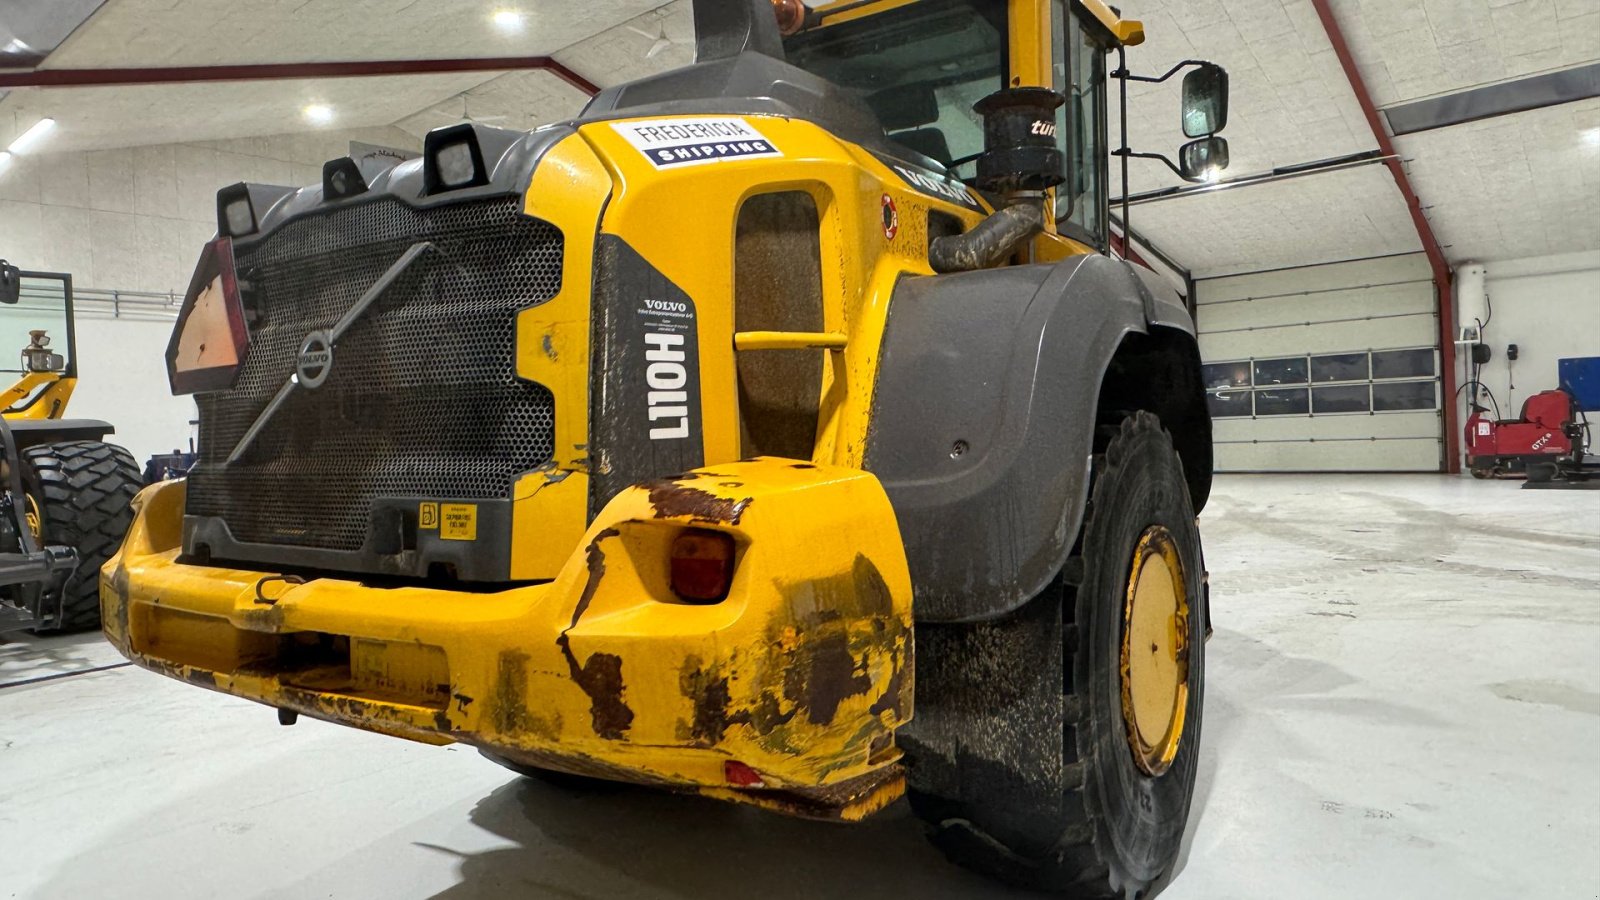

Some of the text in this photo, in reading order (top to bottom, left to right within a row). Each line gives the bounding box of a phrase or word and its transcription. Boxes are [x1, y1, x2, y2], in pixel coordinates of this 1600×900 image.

[633, 122, 750, 143] FREDERICIA
[1031, 119, 1057, 139] tur
[657, 141, 768, 161] SHIPPING
[893, 165, 977, 206] VOLVO
[644, 299, 687, 312] VOLVO
[644, 332, 689, 440] L110H
